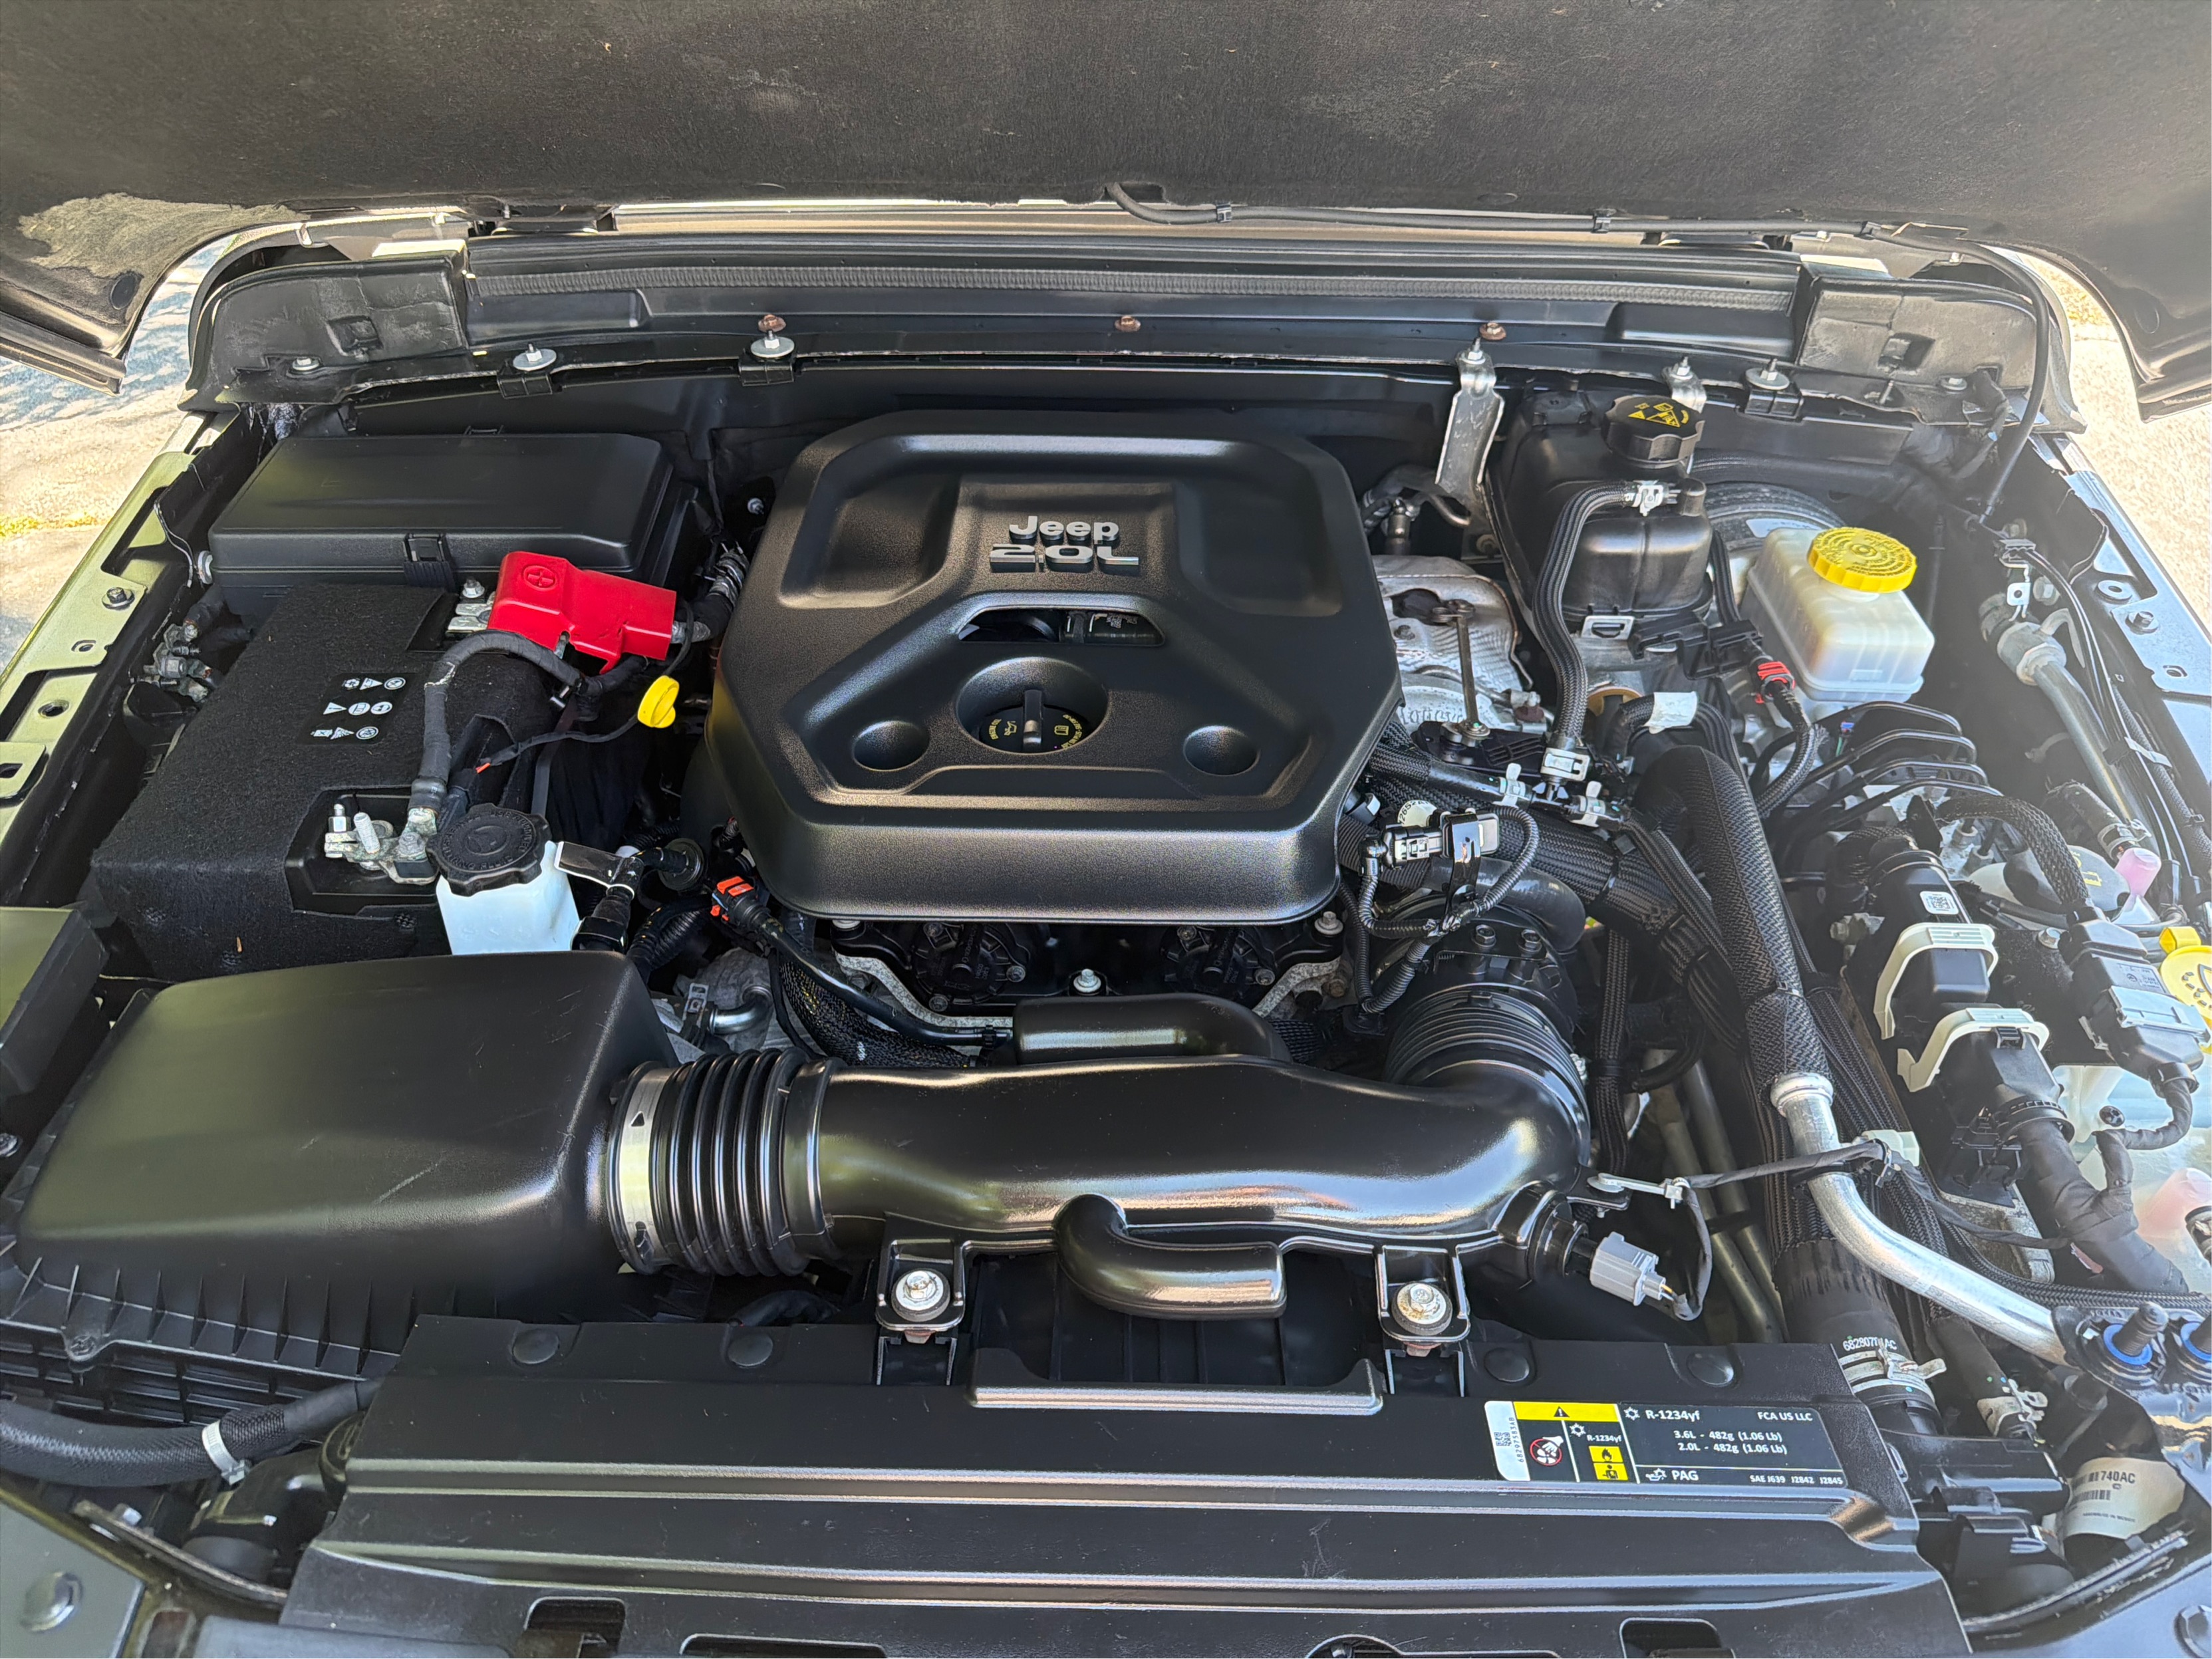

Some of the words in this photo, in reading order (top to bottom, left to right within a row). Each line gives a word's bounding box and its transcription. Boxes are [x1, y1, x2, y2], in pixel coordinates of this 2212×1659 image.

[1009, 516, 1119, 544] Jeep
[990, 543, 1139, 566] 2.0L
[1645, 1410, 1701, 1422] R-1234yf
[1757, 1412, 1778, 1421] FCA
[1780, 1412, 1794, 1421] US
[1795, 1412, 1813, 1422] LLC
[1586, 1434, 1622, 1443] R-1234yf
[1673, 1430, 1696, 1439] 3.6L
[1709, 1432, 1734, 1442] 482g
[1738, 1431, 1764, 1442] (1.06
[1766, 1432, 1783, 1442] Lb)
[1677, 1442, 1701, 1451] 2.0L
[1713, 1444, 1739, 1454] 482g
[1742, 1443, 1769, 1454] (1.06
[1771, 1444, 1788, 1454] Lb)
[1671, 1470, 1699, 1481] PAG
[1767, 1475, 1786, 1483] J639
[1790, 1475, 1814, 1484] J2842
[1819, 1476, 1843, 1485] J2845
